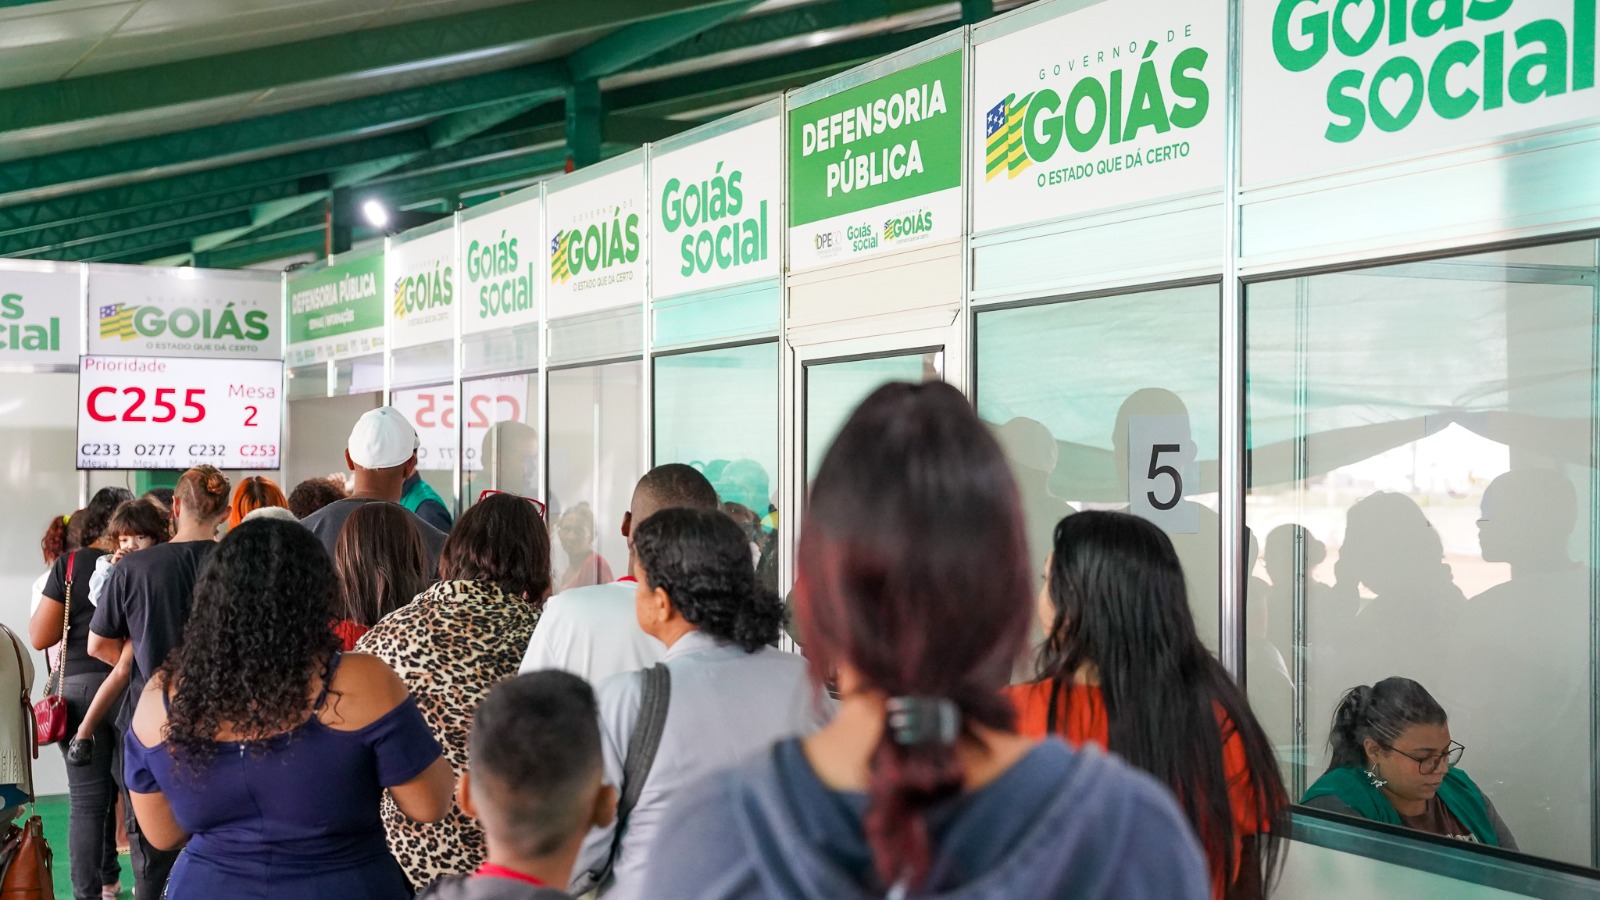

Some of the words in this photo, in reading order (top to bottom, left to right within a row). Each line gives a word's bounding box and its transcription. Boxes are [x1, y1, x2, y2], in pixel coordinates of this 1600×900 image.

[1039, 41, 1137, 80] GOVERNO
[1167, 24, 1192, 42] DE
[1325, 0, 1596, 143] social
[802, 79, 947, 157] DEFENSORIA
[1023, 40, 1209, 162] GOIÁS
[827, 139, 924, 198] PÚBLICA
[1037, 173, 1046, 187] O
[1048, 162, 1094, 185] ESTADO
[1097, 157, 1122, 175] QUE
[1125, 148, 1143, 169] DÁ
[1146, 141, 1190, 164] CERTO
[661, 160, 743, 232] Goiás
[567, 206, 640, 276] GOIÁS
[681, 199, 768, 277] social
[847, 222, 871, 240] Goiás
[853, 232, 878, 252] social
[893, 209, 932, 238] GOIÁS
[467, 229, 518, 283] Goiás
[292, 282, 338, 315] DEFENSORIA
[339, 272, 376, 303] PÚBLICA
[405, 260, 453, 313] GOIÁS
[480, 262, 533, 319] social
[578, 279, 596, 291] ESTADO
[597, 276, 607, 287] QUE
[616, 270, 633, 283] CERTO
[134, 302, 269, 341] GOIÁS
[85, 358, 166, 372] Prioridade
[156, 343, 191, 351] ESTADO
[193, 343, 212, 351] QUE
[229, 344, 258, 352] CERTO
[86, 386, 206, 423] C255
[228, 384, 275, 398] Mesa
[243, 405, 258, 426] 2
[81, 443, 120, 456] C233
[188, 444, 226, 456] C232
[240, 444, 276, 456] C253
[1147, 444, 1183, 510] 5
